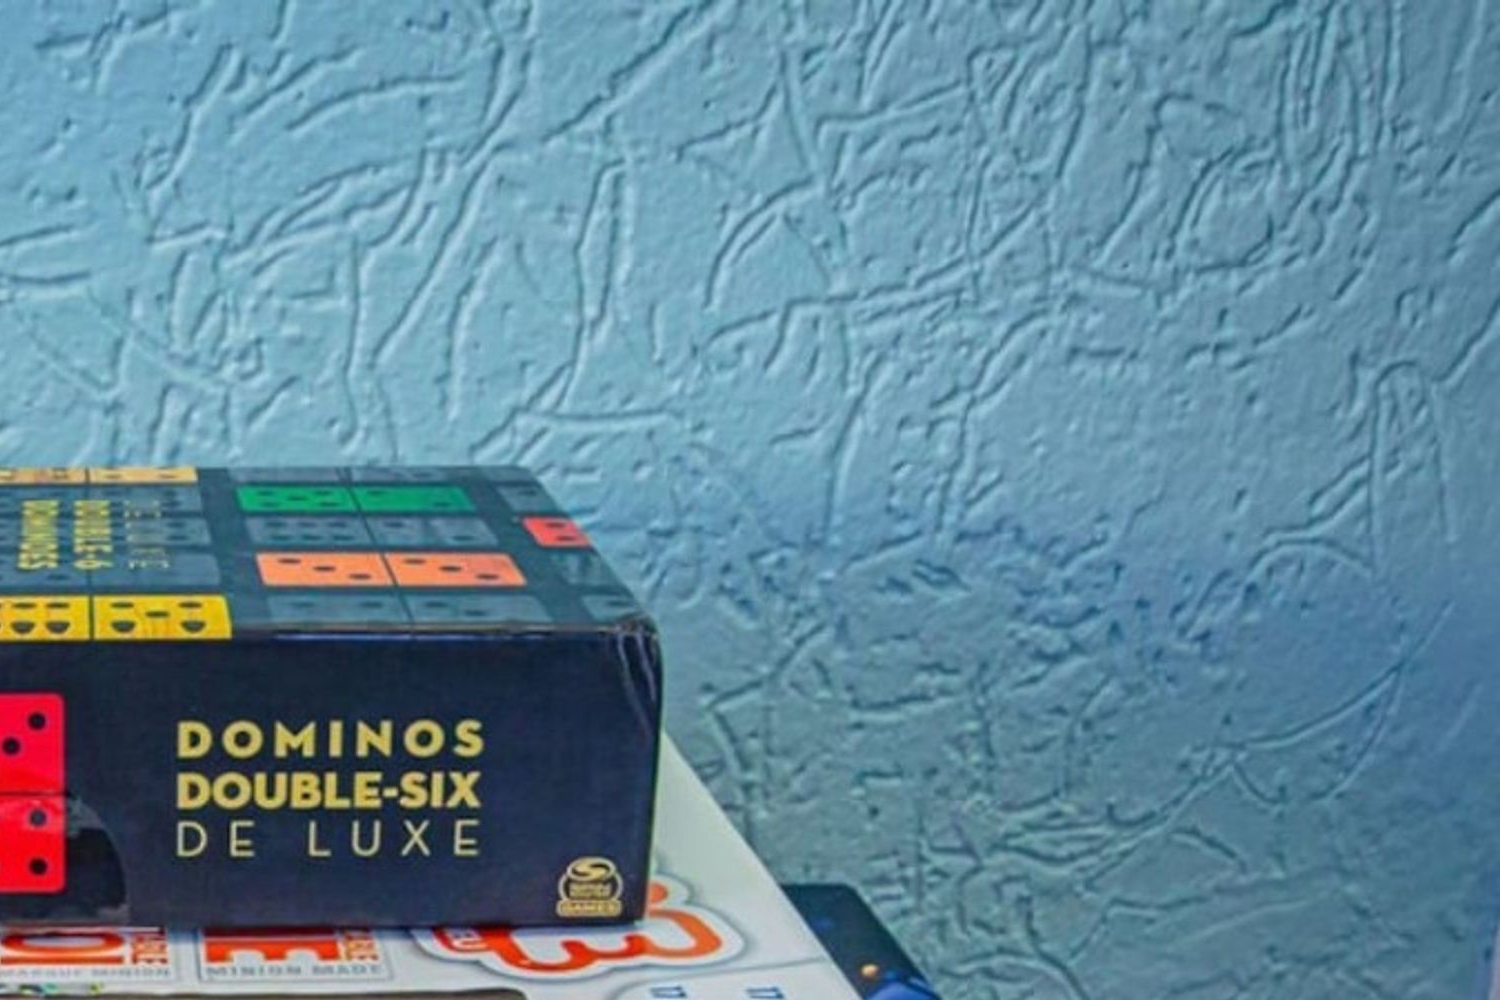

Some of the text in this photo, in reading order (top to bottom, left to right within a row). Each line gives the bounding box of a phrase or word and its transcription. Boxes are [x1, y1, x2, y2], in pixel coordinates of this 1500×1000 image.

[176, 719, 485, 758] DOMINOS
[176, 771, 481, 810] DOUBLE-SIX
[176, 819, 480, 858] DE LUXE
